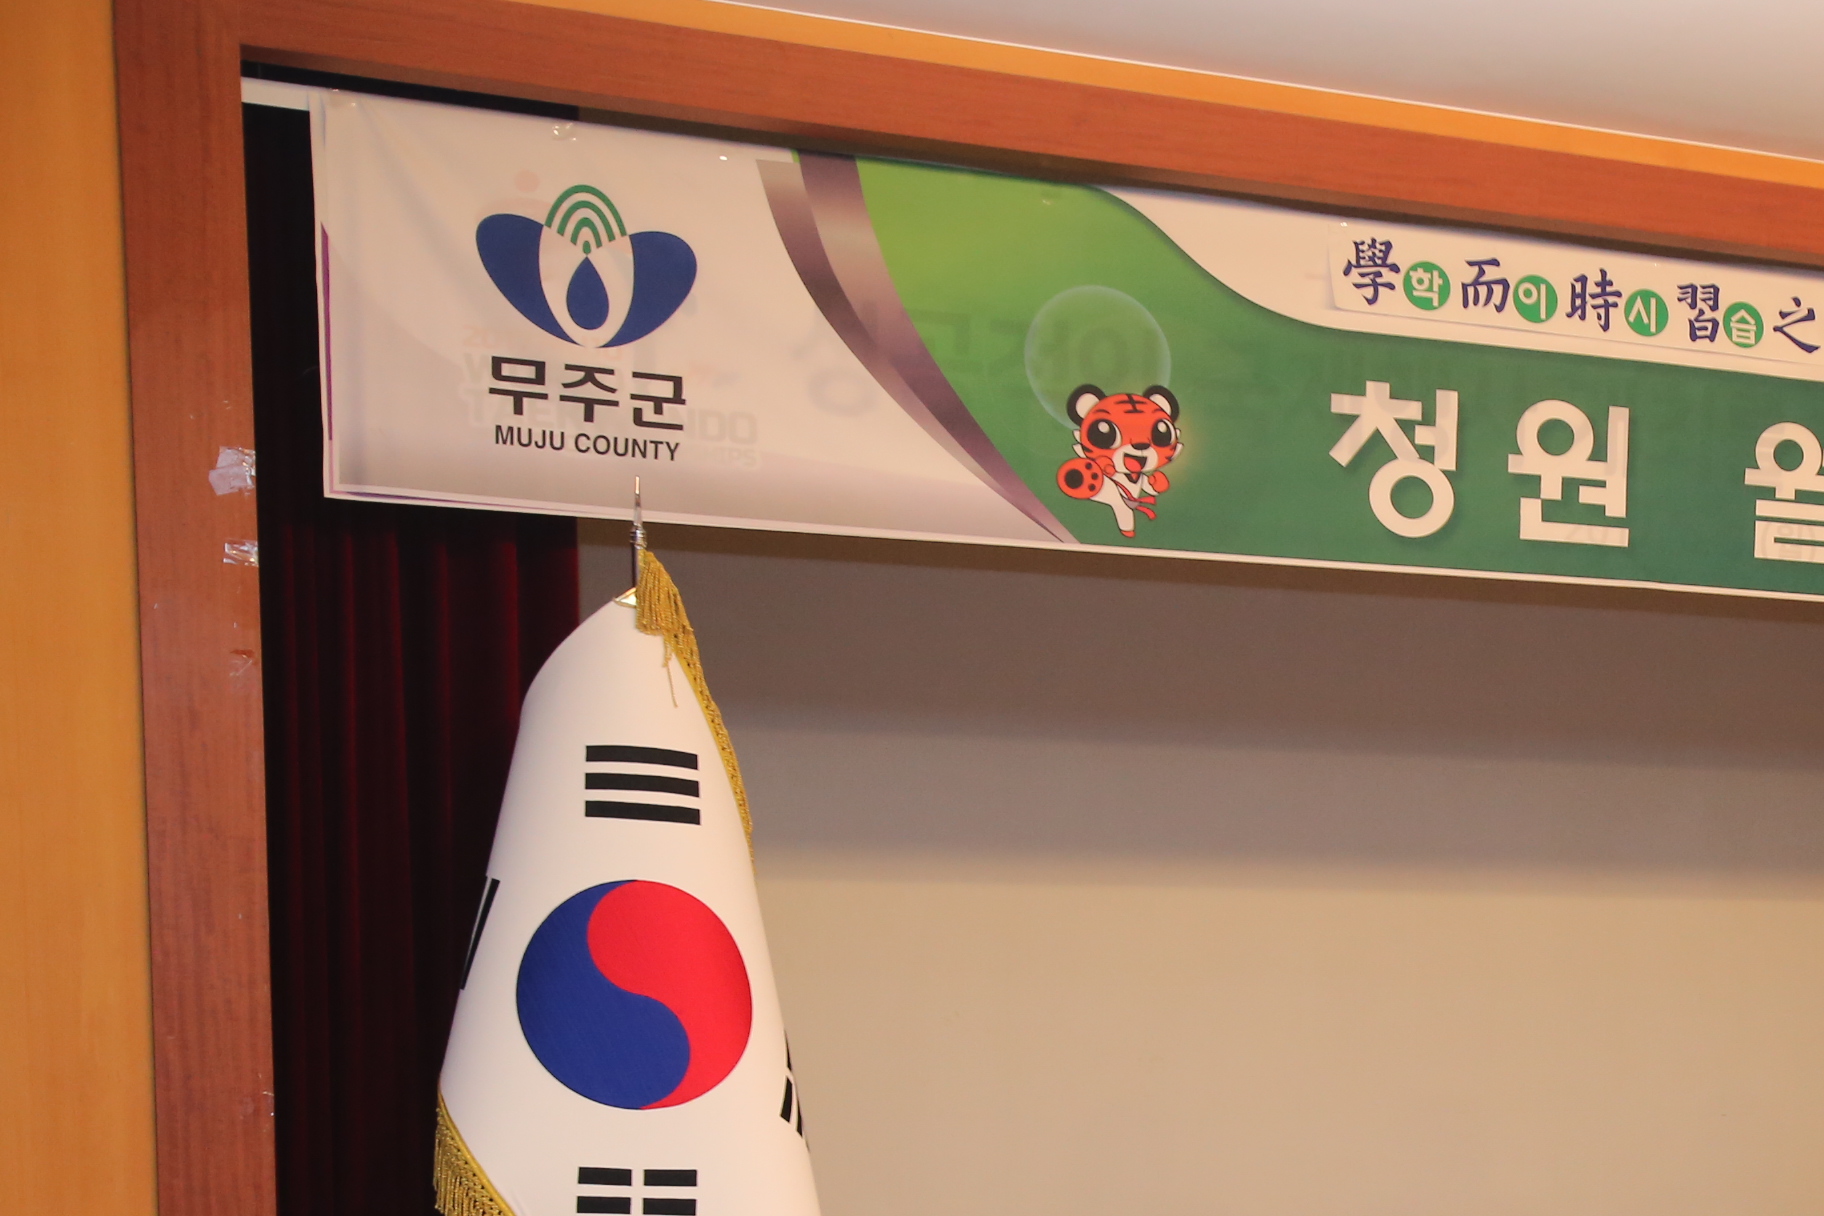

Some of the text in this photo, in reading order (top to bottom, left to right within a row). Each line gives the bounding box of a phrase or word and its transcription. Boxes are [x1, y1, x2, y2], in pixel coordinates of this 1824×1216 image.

[488, 355, 687, 431] 무주군
[494, 424, 566, 451] MUJU
[574, 432, 681, 462] COUNTY
[1328, 380, 1630, 548] 청원
